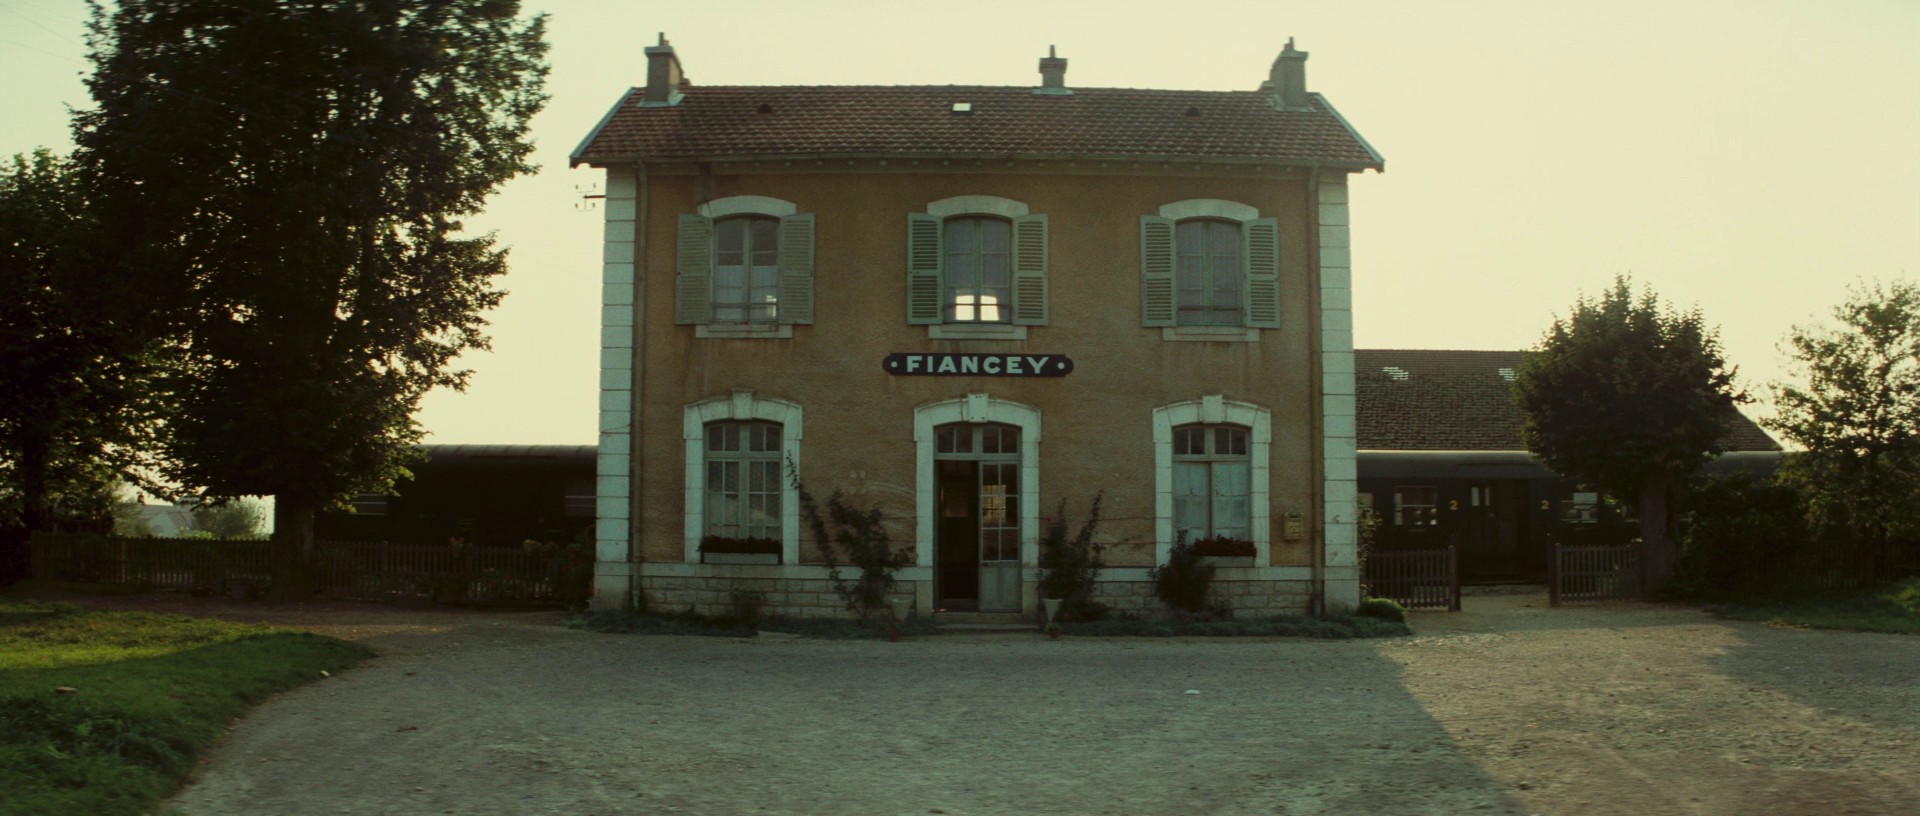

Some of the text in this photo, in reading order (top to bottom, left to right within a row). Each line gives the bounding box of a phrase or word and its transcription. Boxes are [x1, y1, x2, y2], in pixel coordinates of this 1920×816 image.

[906, 355, 1049, 374] FIANCEY
[1449, 499, 1458, 510] 2
[1540, 499, 1549, 510] 2
